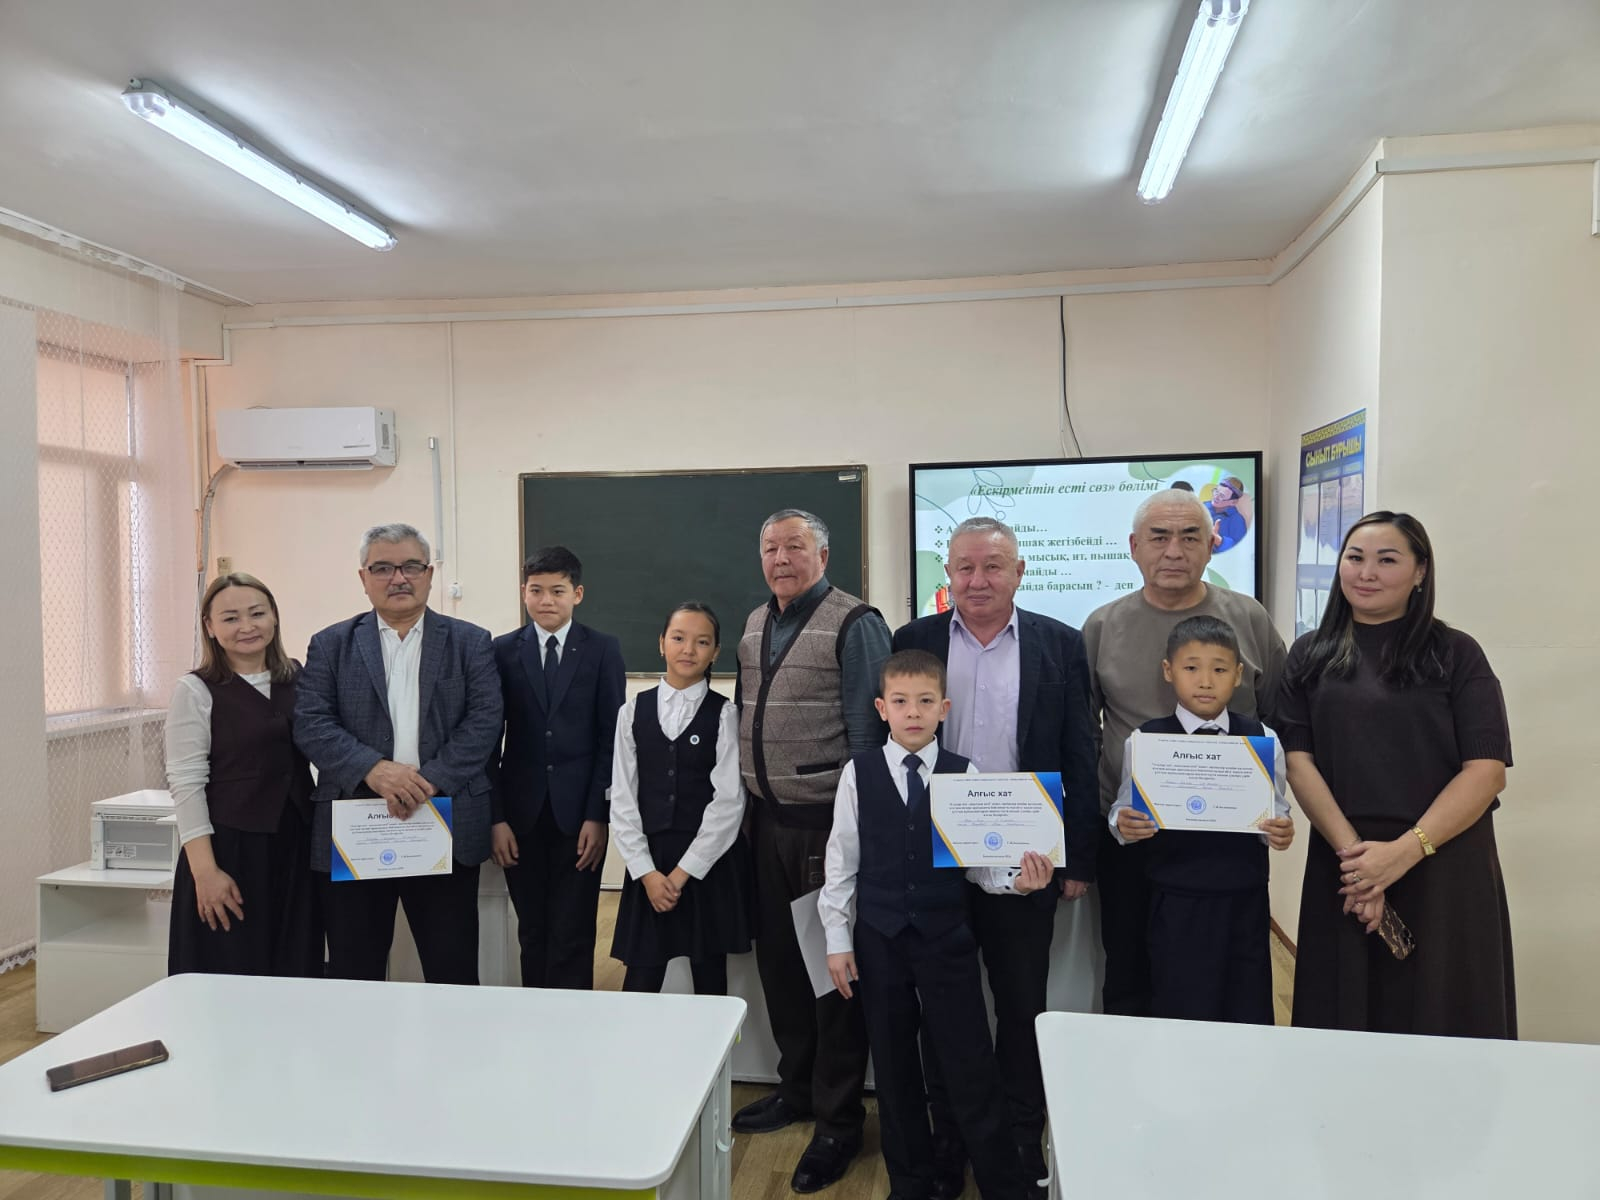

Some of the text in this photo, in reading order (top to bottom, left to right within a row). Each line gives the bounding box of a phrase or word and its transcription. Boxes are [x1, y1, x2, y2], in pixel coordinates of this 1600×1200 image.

[1306, 446, 1330, 468] СЫНЫП
[970, 480, 1159, 498] «Ескірмейтін есті сөз» бөлімі
[1017, 583, 1044, 592] айда
[1205, 753, 1222, 761] хат
